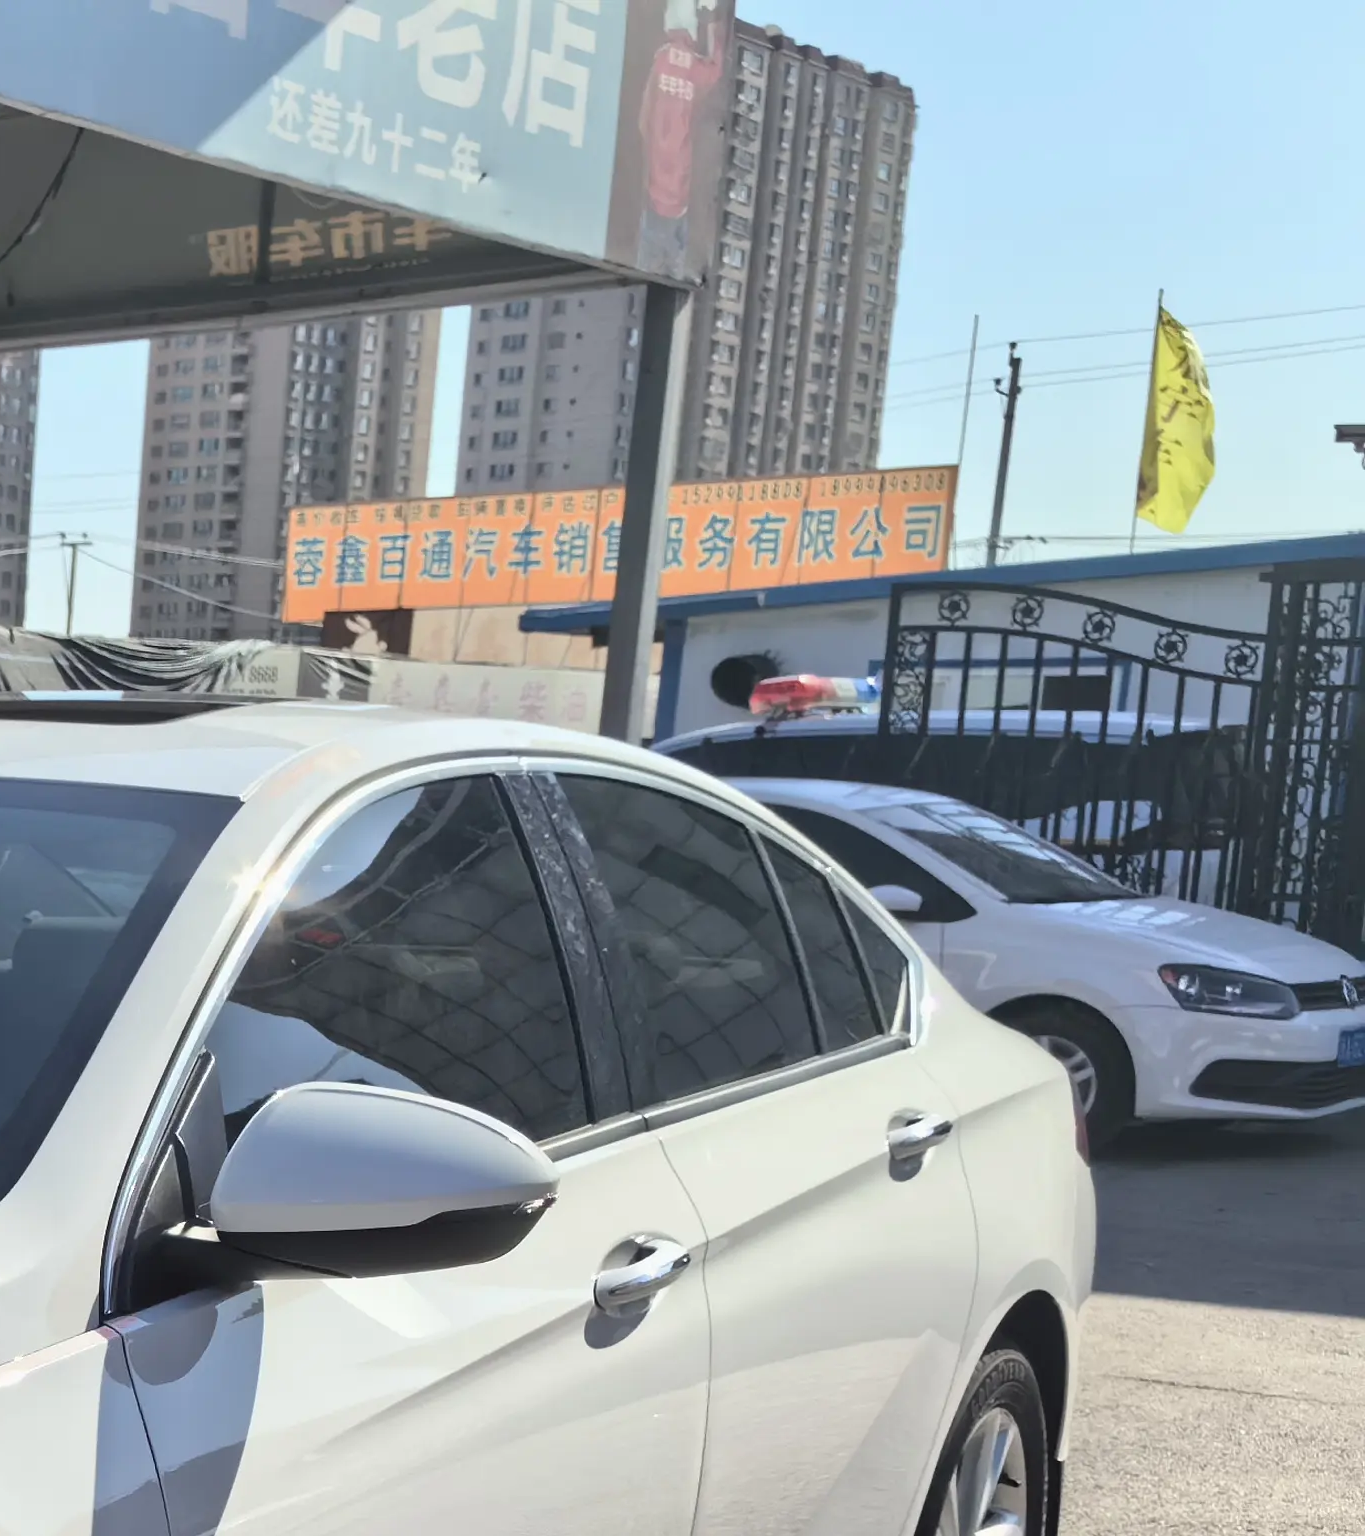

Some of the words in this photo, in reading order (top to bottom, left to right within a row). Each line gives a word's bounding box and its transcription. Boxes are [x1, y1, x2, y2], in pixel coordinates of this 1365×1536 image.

[266, 75, 482, 193] 还差九十二年
